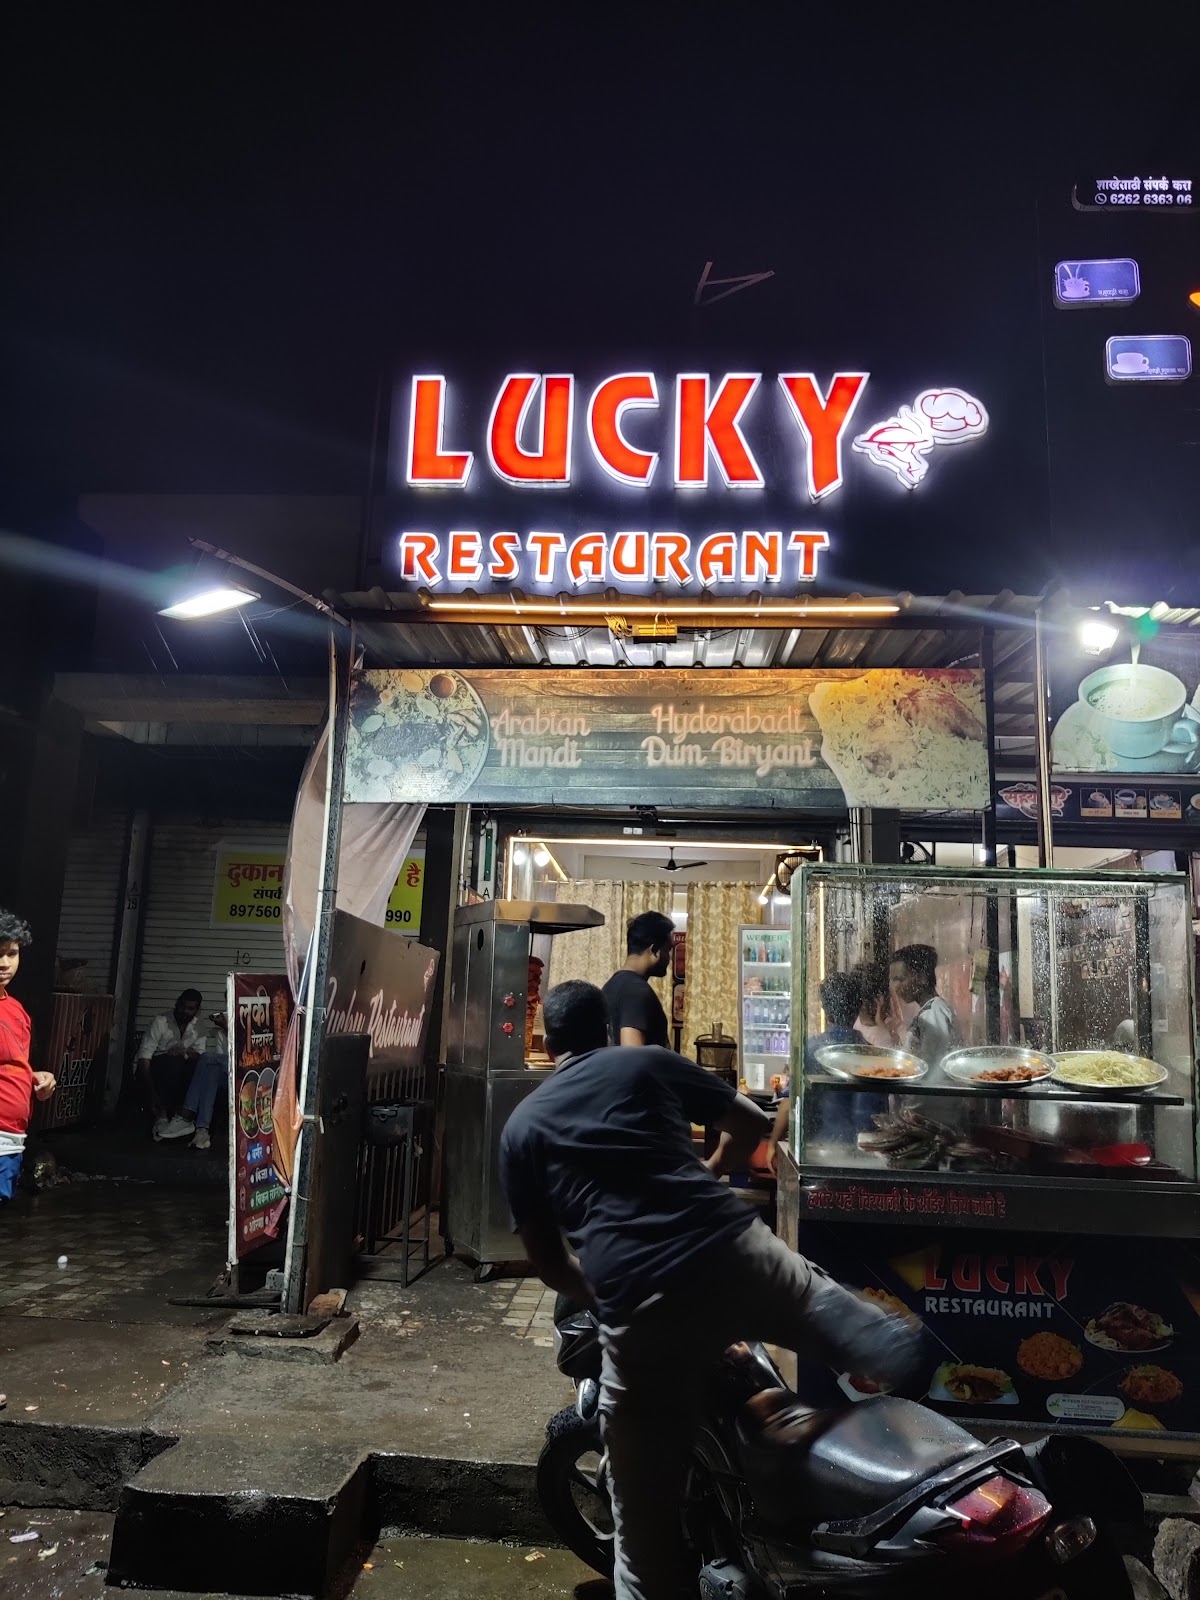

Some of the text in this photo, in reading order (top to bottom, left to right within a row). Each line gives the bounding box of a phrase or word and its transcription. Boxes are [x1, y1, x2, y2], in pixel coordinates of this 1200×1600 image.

[1096, 176, 1192, 191] शाखेसाठी संपर्क करा
[1110, 194, 1192, 204] 6262 6363 06
[406, 371, 870, 503] LUCKY
[399, 531, 829, 587] RESTAURANT
[493, 707, 592, 738] Arabian
[651, 704, 807, 744] Hyderabadi
[497, 736, 582, 769] Mandi
[641, 735, 817, 777] Dum Biryani
[227, 862, 421, 887] दुकान है
[229, 904, 281, 918] 897560
[367, 989, 426, 1058] Restaurant
[924, 1254, 1074, 1302] LUCKY
[925, 1296, 1055, 1318] RESTAURANT
